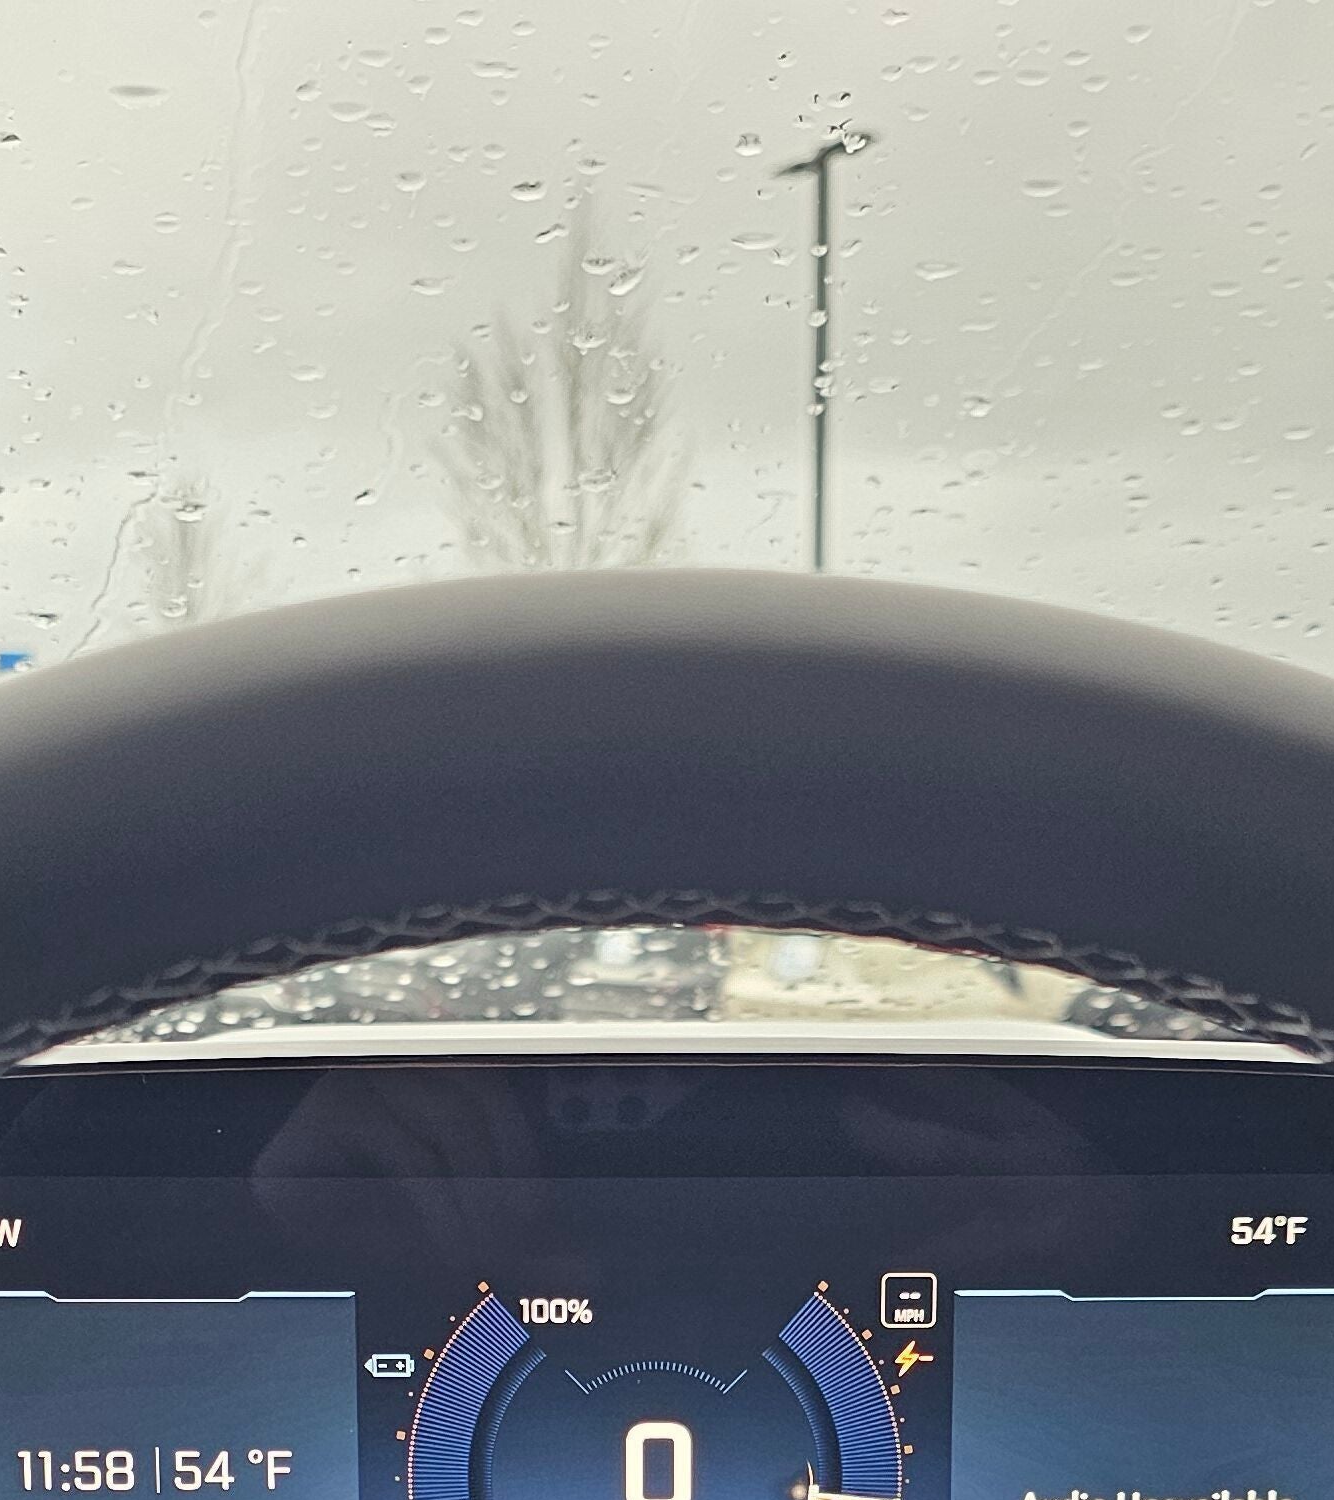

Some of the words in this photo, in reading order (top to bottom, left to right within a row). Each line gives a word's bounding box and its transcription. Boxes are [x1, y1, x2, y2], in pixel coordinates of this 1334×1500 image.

[1230, 1215, 1309, 1245] 54°F
[519, 1299, 593, 1325] 100%
[894, 1308, 925, 1324] MPH
[17, 1450, 135, 1492] 11:58
[174, 1450, 235, 1491] 54
